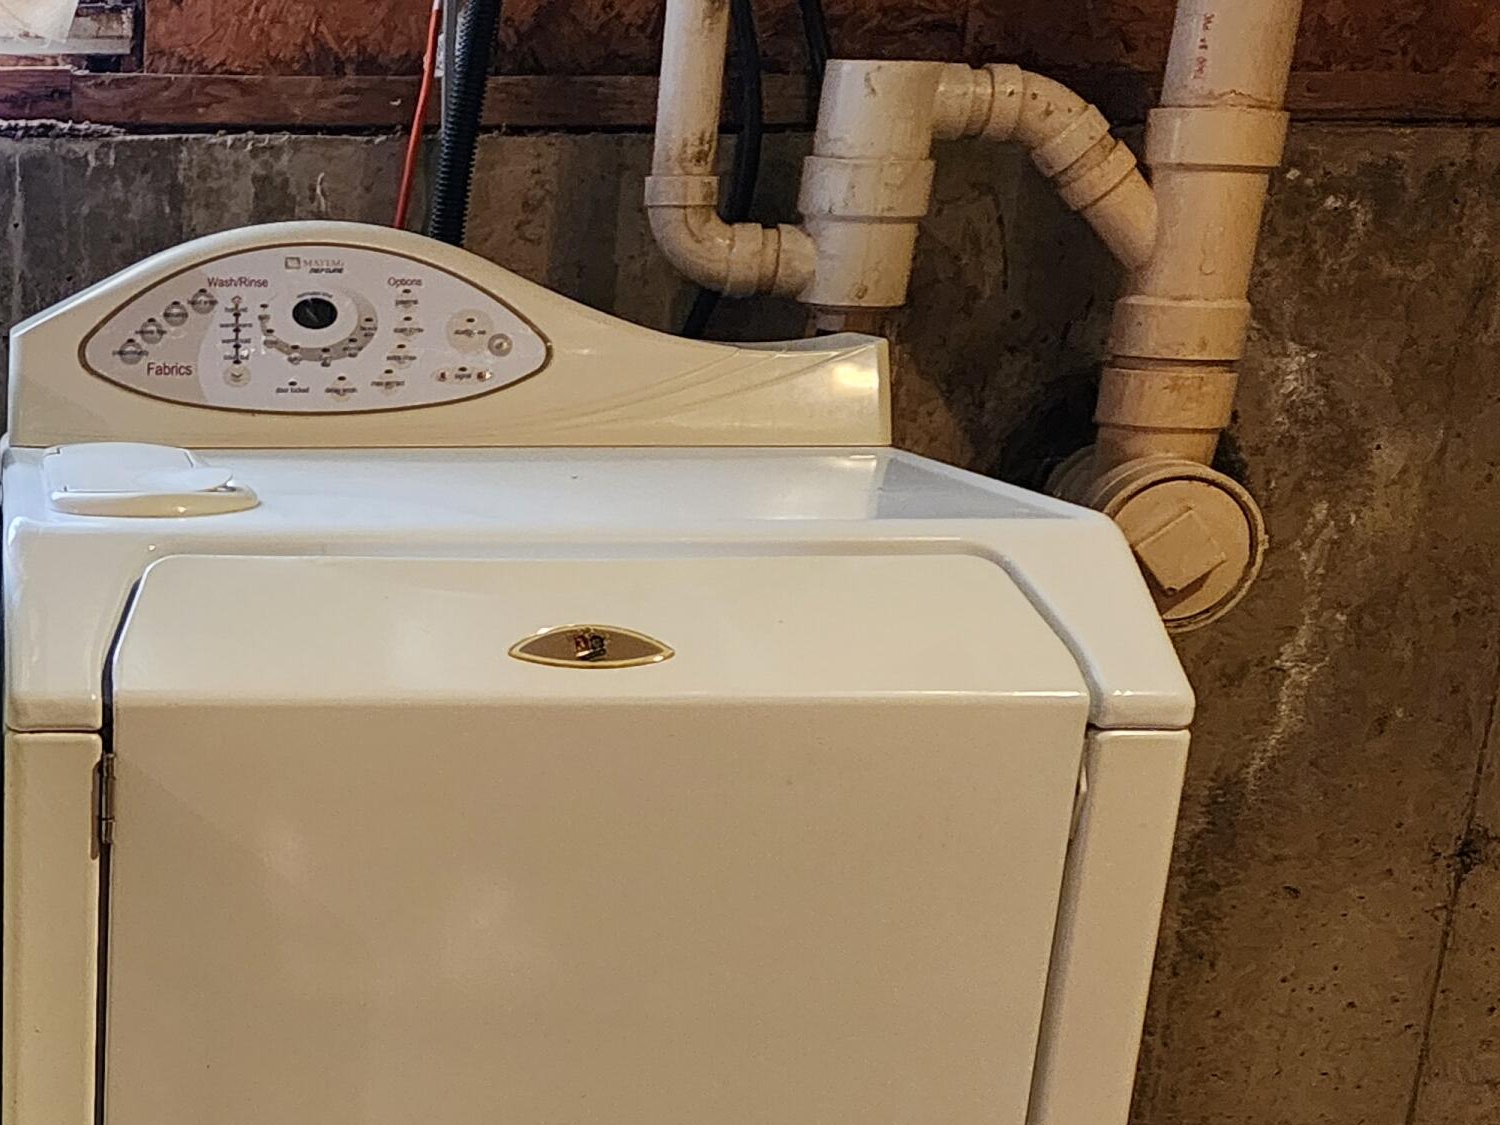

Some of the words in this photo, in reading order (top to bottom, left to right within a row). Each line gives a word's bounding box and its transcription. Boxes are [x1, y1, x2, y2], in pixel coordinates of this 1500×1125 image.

[207, 277, 268, 288] Wash/Rinse
[388, 276, 422, 288] Options
[147, 361, 192, 376] Fabrics
